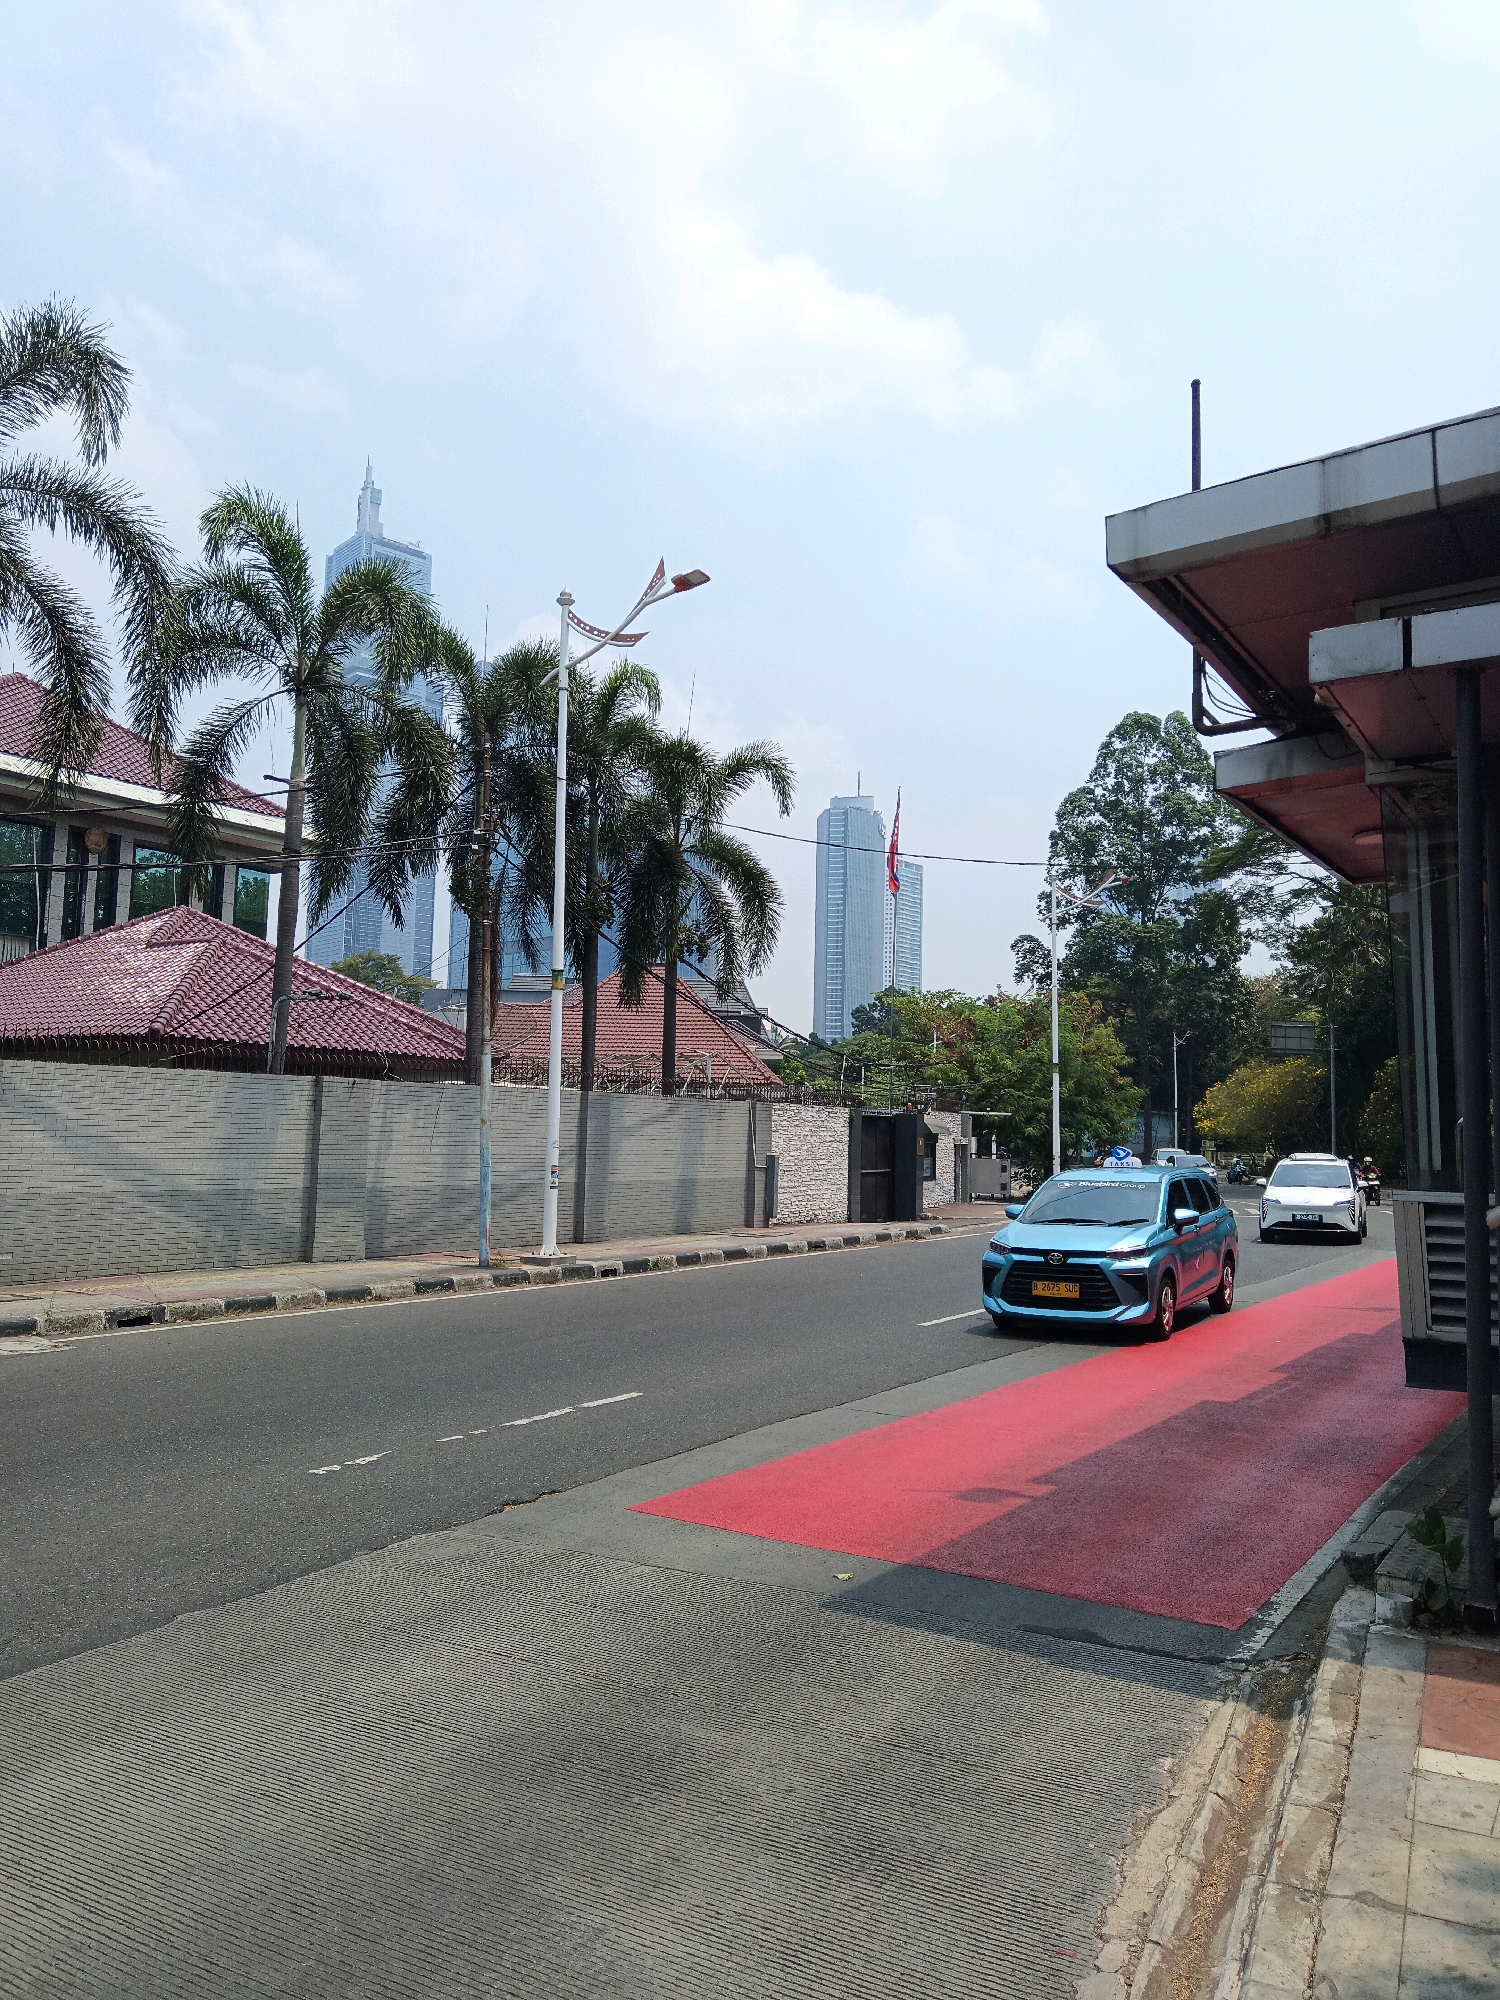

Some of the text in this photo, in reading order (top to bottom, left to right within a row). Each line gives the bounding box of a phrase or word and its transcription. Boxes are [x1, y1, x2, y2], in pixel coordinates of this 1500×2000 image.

[1120, 1182, 1146, 1190] Group
[1033, 1282, 1038, 1290] B
[1042, 1282, 1061, 1292] 2675
